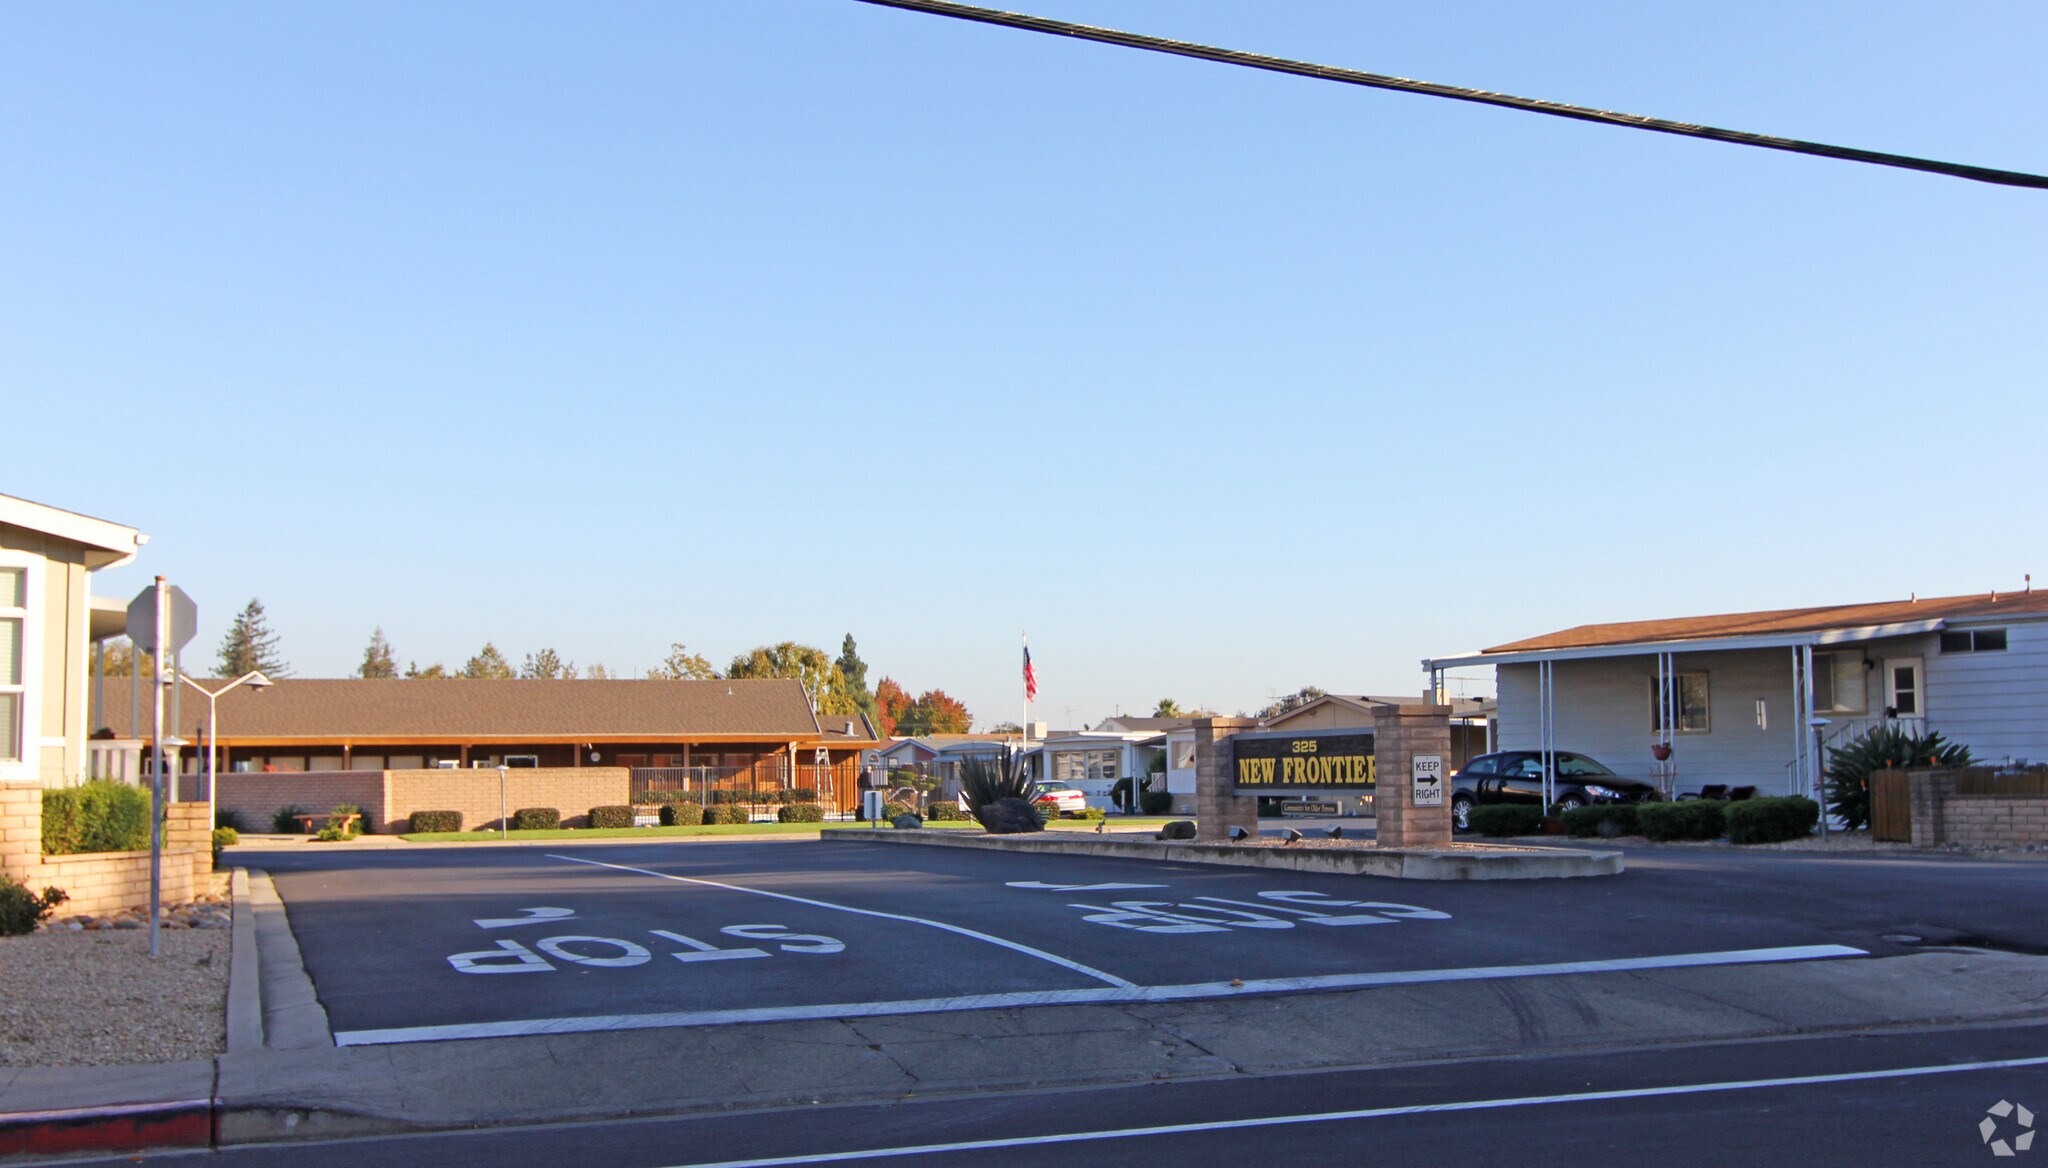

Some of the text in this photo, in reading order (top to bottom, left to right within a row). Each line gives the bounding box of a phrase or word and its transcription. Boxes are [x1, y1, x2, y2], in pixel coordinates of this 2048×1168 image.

[1292, 741, 1317, 753] 325
[1239, 755, 1376, 784] NEW FRONTIER
[1415, 761, 1440, 771] KEEP
[1415, 789, 1441, 799] RIGHT
[1066, 890, 1452, 934] STOP
[446, 924, 846, 974] STOP
